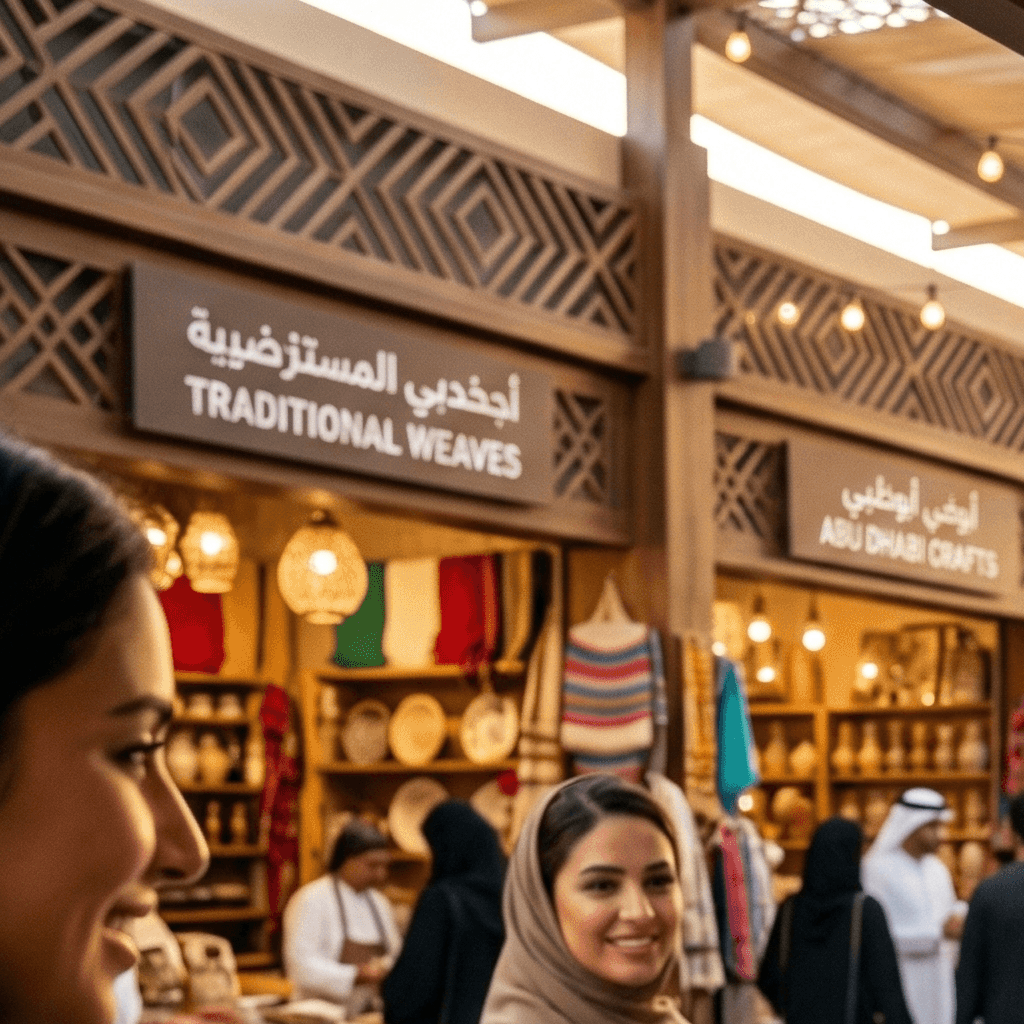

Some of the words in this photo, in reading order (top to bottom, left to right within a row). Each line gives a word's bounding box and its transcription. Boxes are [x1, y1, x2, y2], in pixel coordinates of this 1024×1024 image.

[183, 374, 403, 457] TRADITIONAL
[405, 422, 523, 479] WEAVES
[819, 514, 864, 552] ABU
[865, 523, 927, 565] DHABI
[927, 537, 999, 580] CRAFTS
